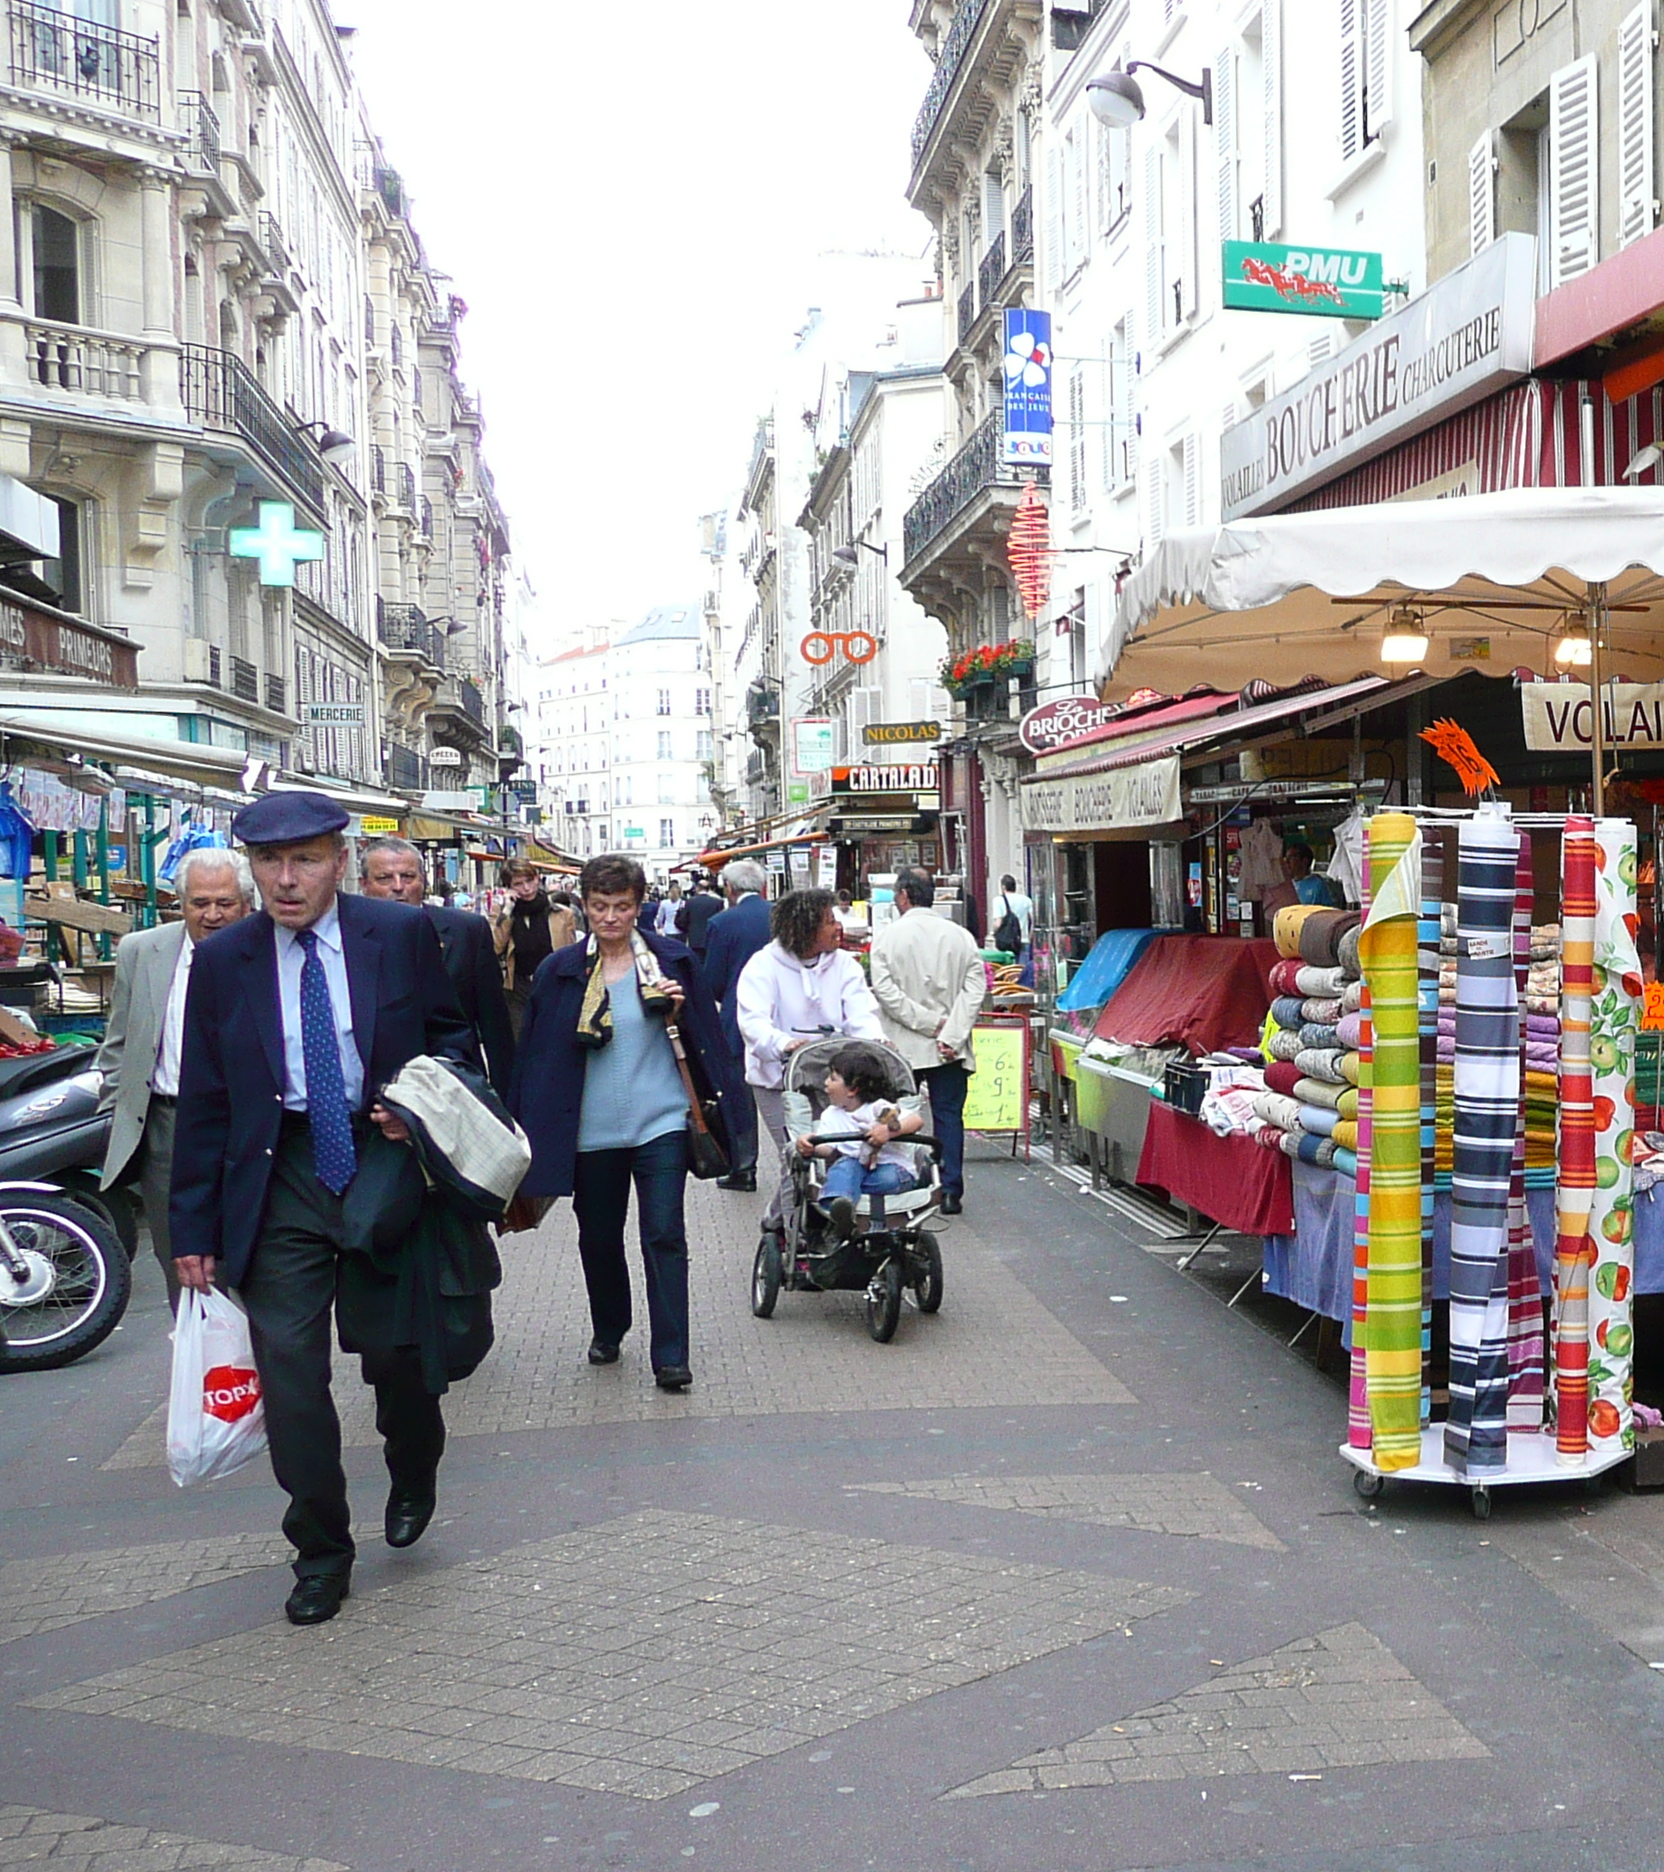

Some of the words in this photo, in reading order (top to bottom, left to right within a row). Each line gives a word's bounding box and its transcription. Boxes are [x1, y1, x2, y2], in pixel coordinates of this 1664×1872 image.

[1283, 250, 1369, 285] PMU
[1265, 334, 1400, 486] BOUCHERIE
[1402, 307, 1500, 405] CHARCUTERIE
[58, 625, 112, 676] PRIMEURS
[310, 707, 363, 722] MERCERIE
[1055, 699, 1084, 716] La
[865, 724, 938, 742] NICOLAS
